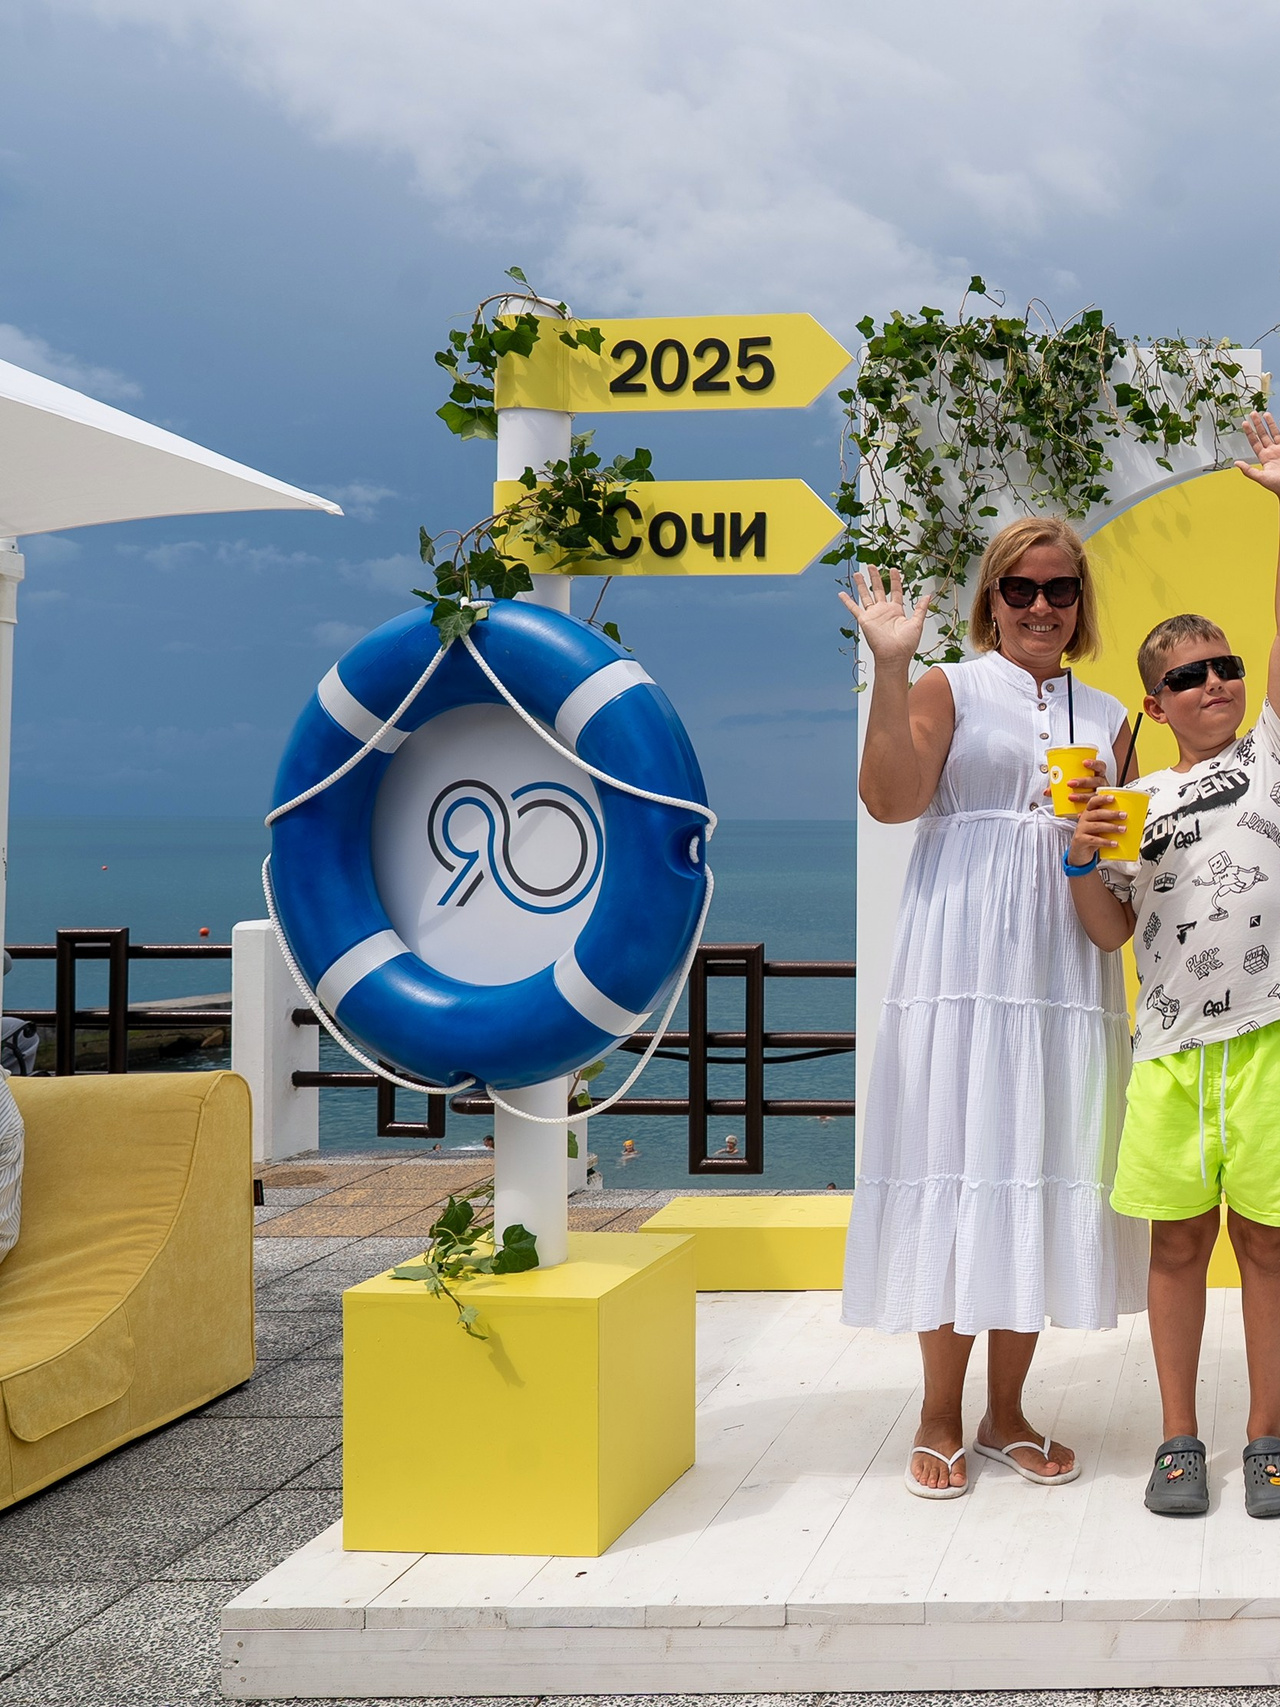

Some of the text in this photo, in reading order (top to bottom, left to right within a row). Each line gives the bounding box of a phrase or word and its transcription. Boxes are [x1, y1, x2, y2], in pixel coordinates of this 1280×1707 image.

[610, 337, 775, 392] 2025
[603, 499, 767, 559] Сочи
[427, 779, 604, 915] 90
